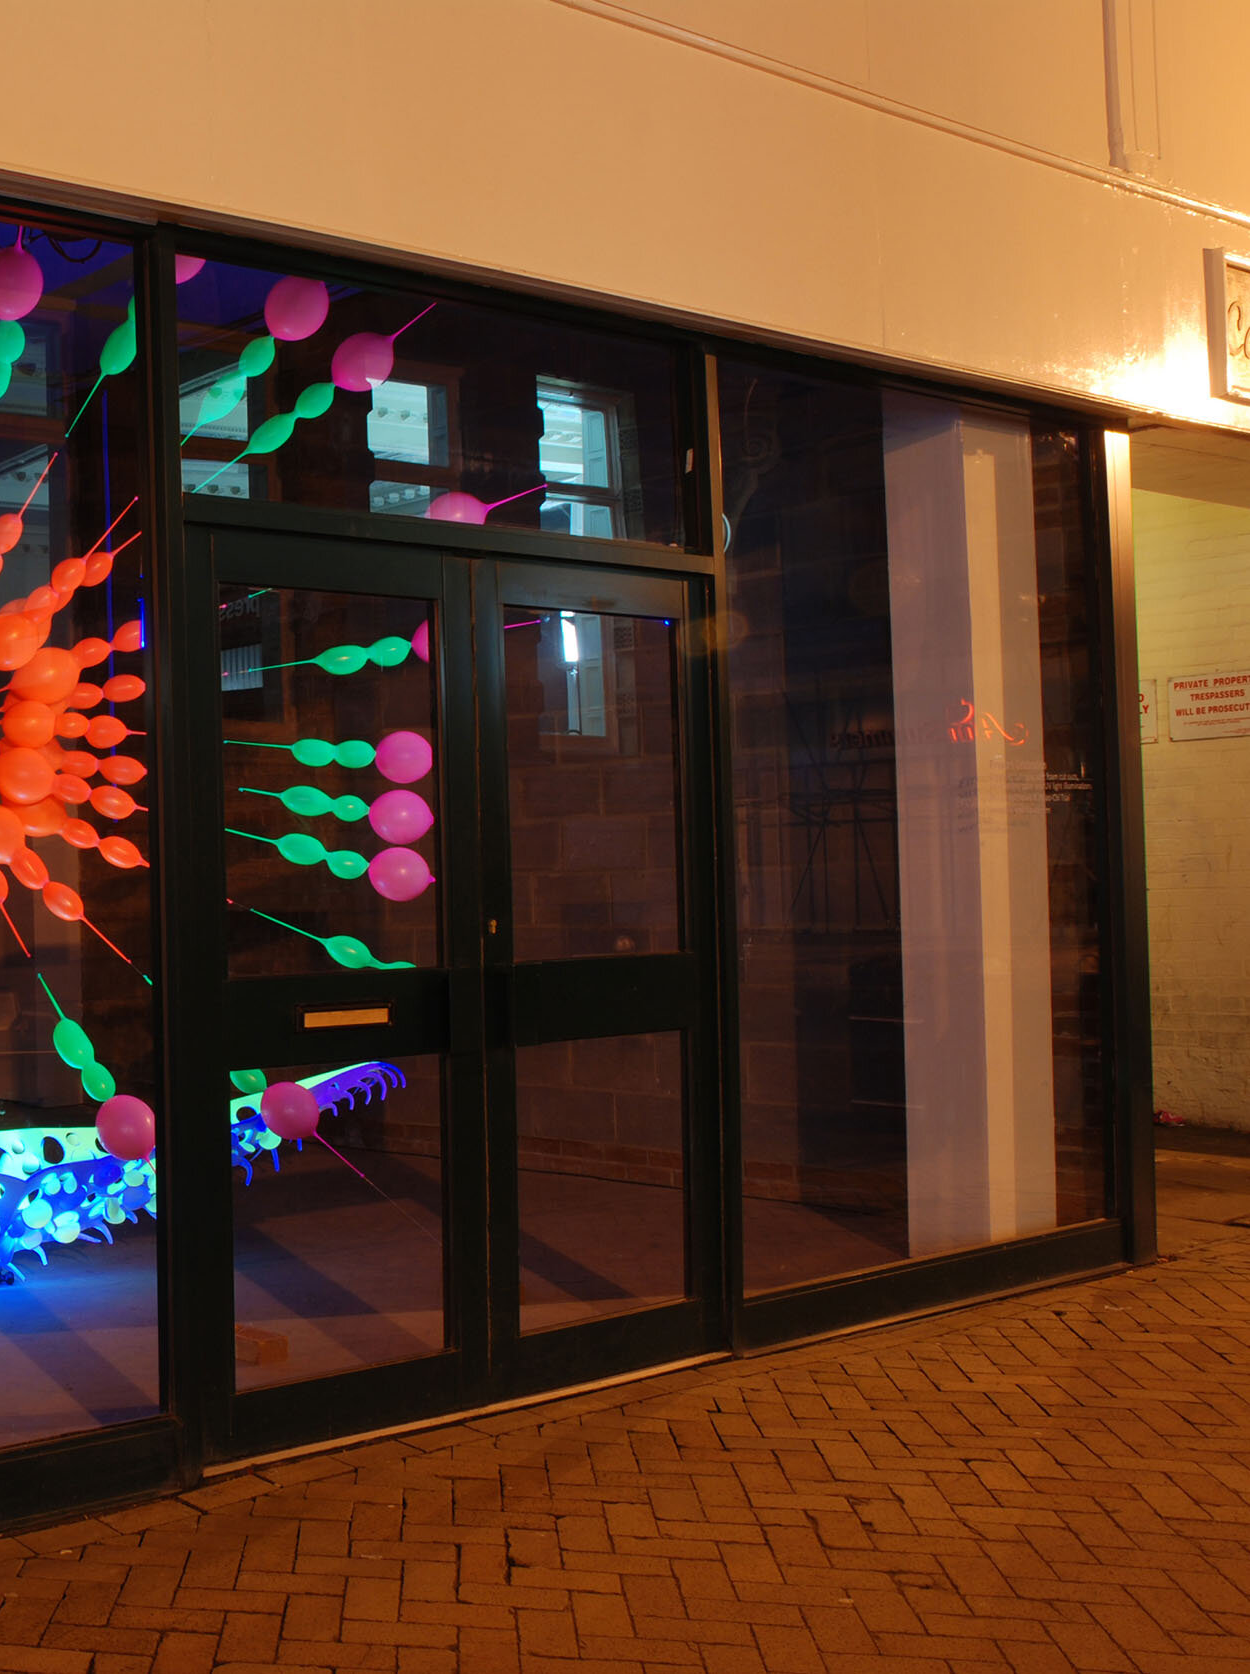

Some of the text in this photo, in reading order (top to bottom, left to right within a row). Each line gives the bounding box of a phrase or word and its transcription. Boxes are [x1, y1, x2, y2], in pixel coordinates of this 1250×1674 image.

[1174, 680, 1208, 690] PRIVATE
[1190, 689, 1245, 701] TRESPASSERS
[1175, 707, 1194, 717] WILL
[1196, 705, 1207, 715] BE
